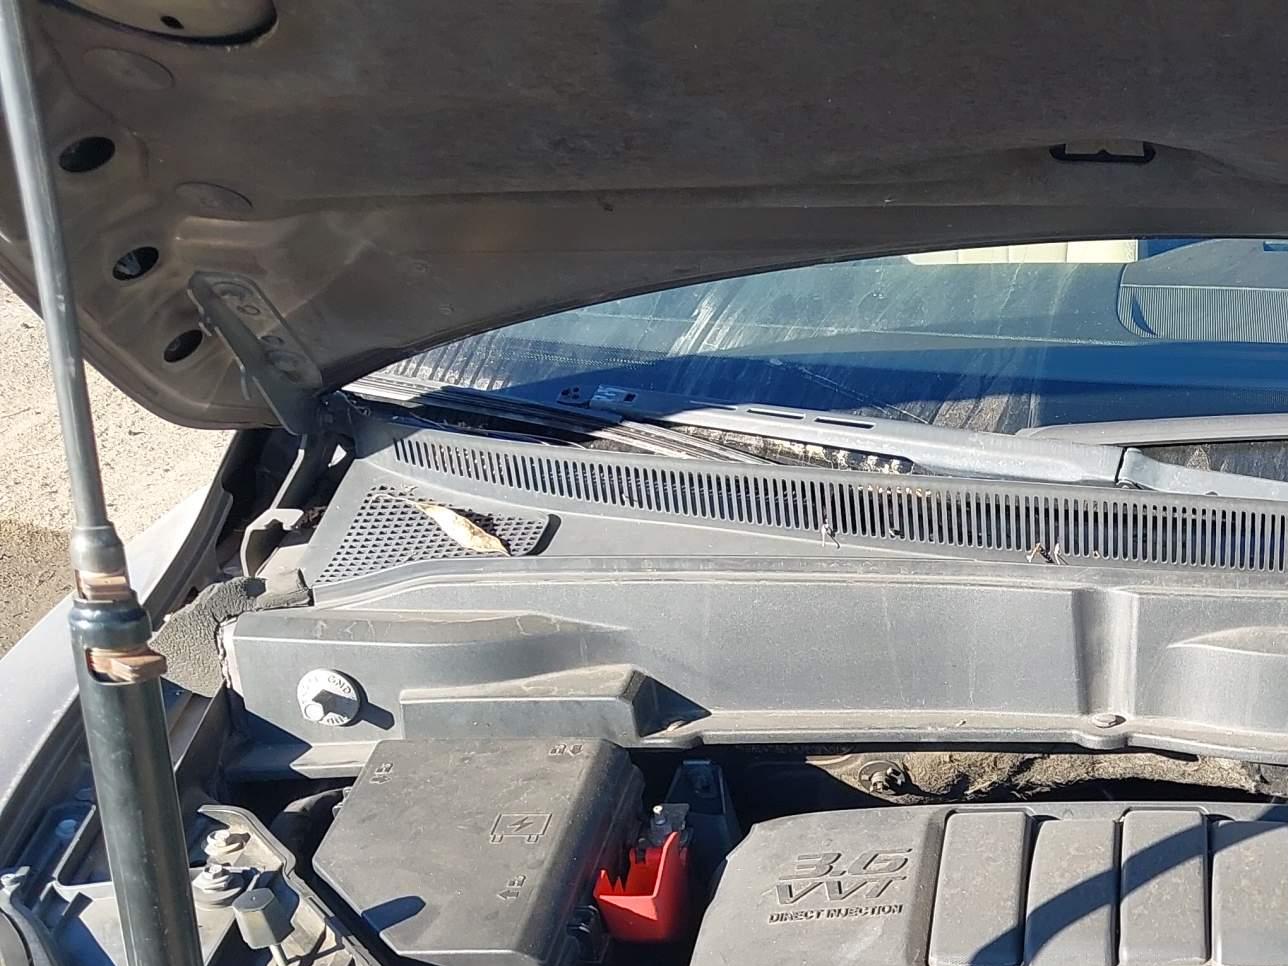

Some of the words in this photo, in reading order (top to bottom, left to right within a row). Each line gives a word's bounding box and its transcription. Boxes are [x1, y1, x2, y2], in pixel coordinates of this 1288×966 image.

[779, 848, 913, 880] 3.6
[776, 876, 907, 904] VVT
[768, 908, 824, 923] DIRECT
[826, 904, 903, 918] INJECTION
